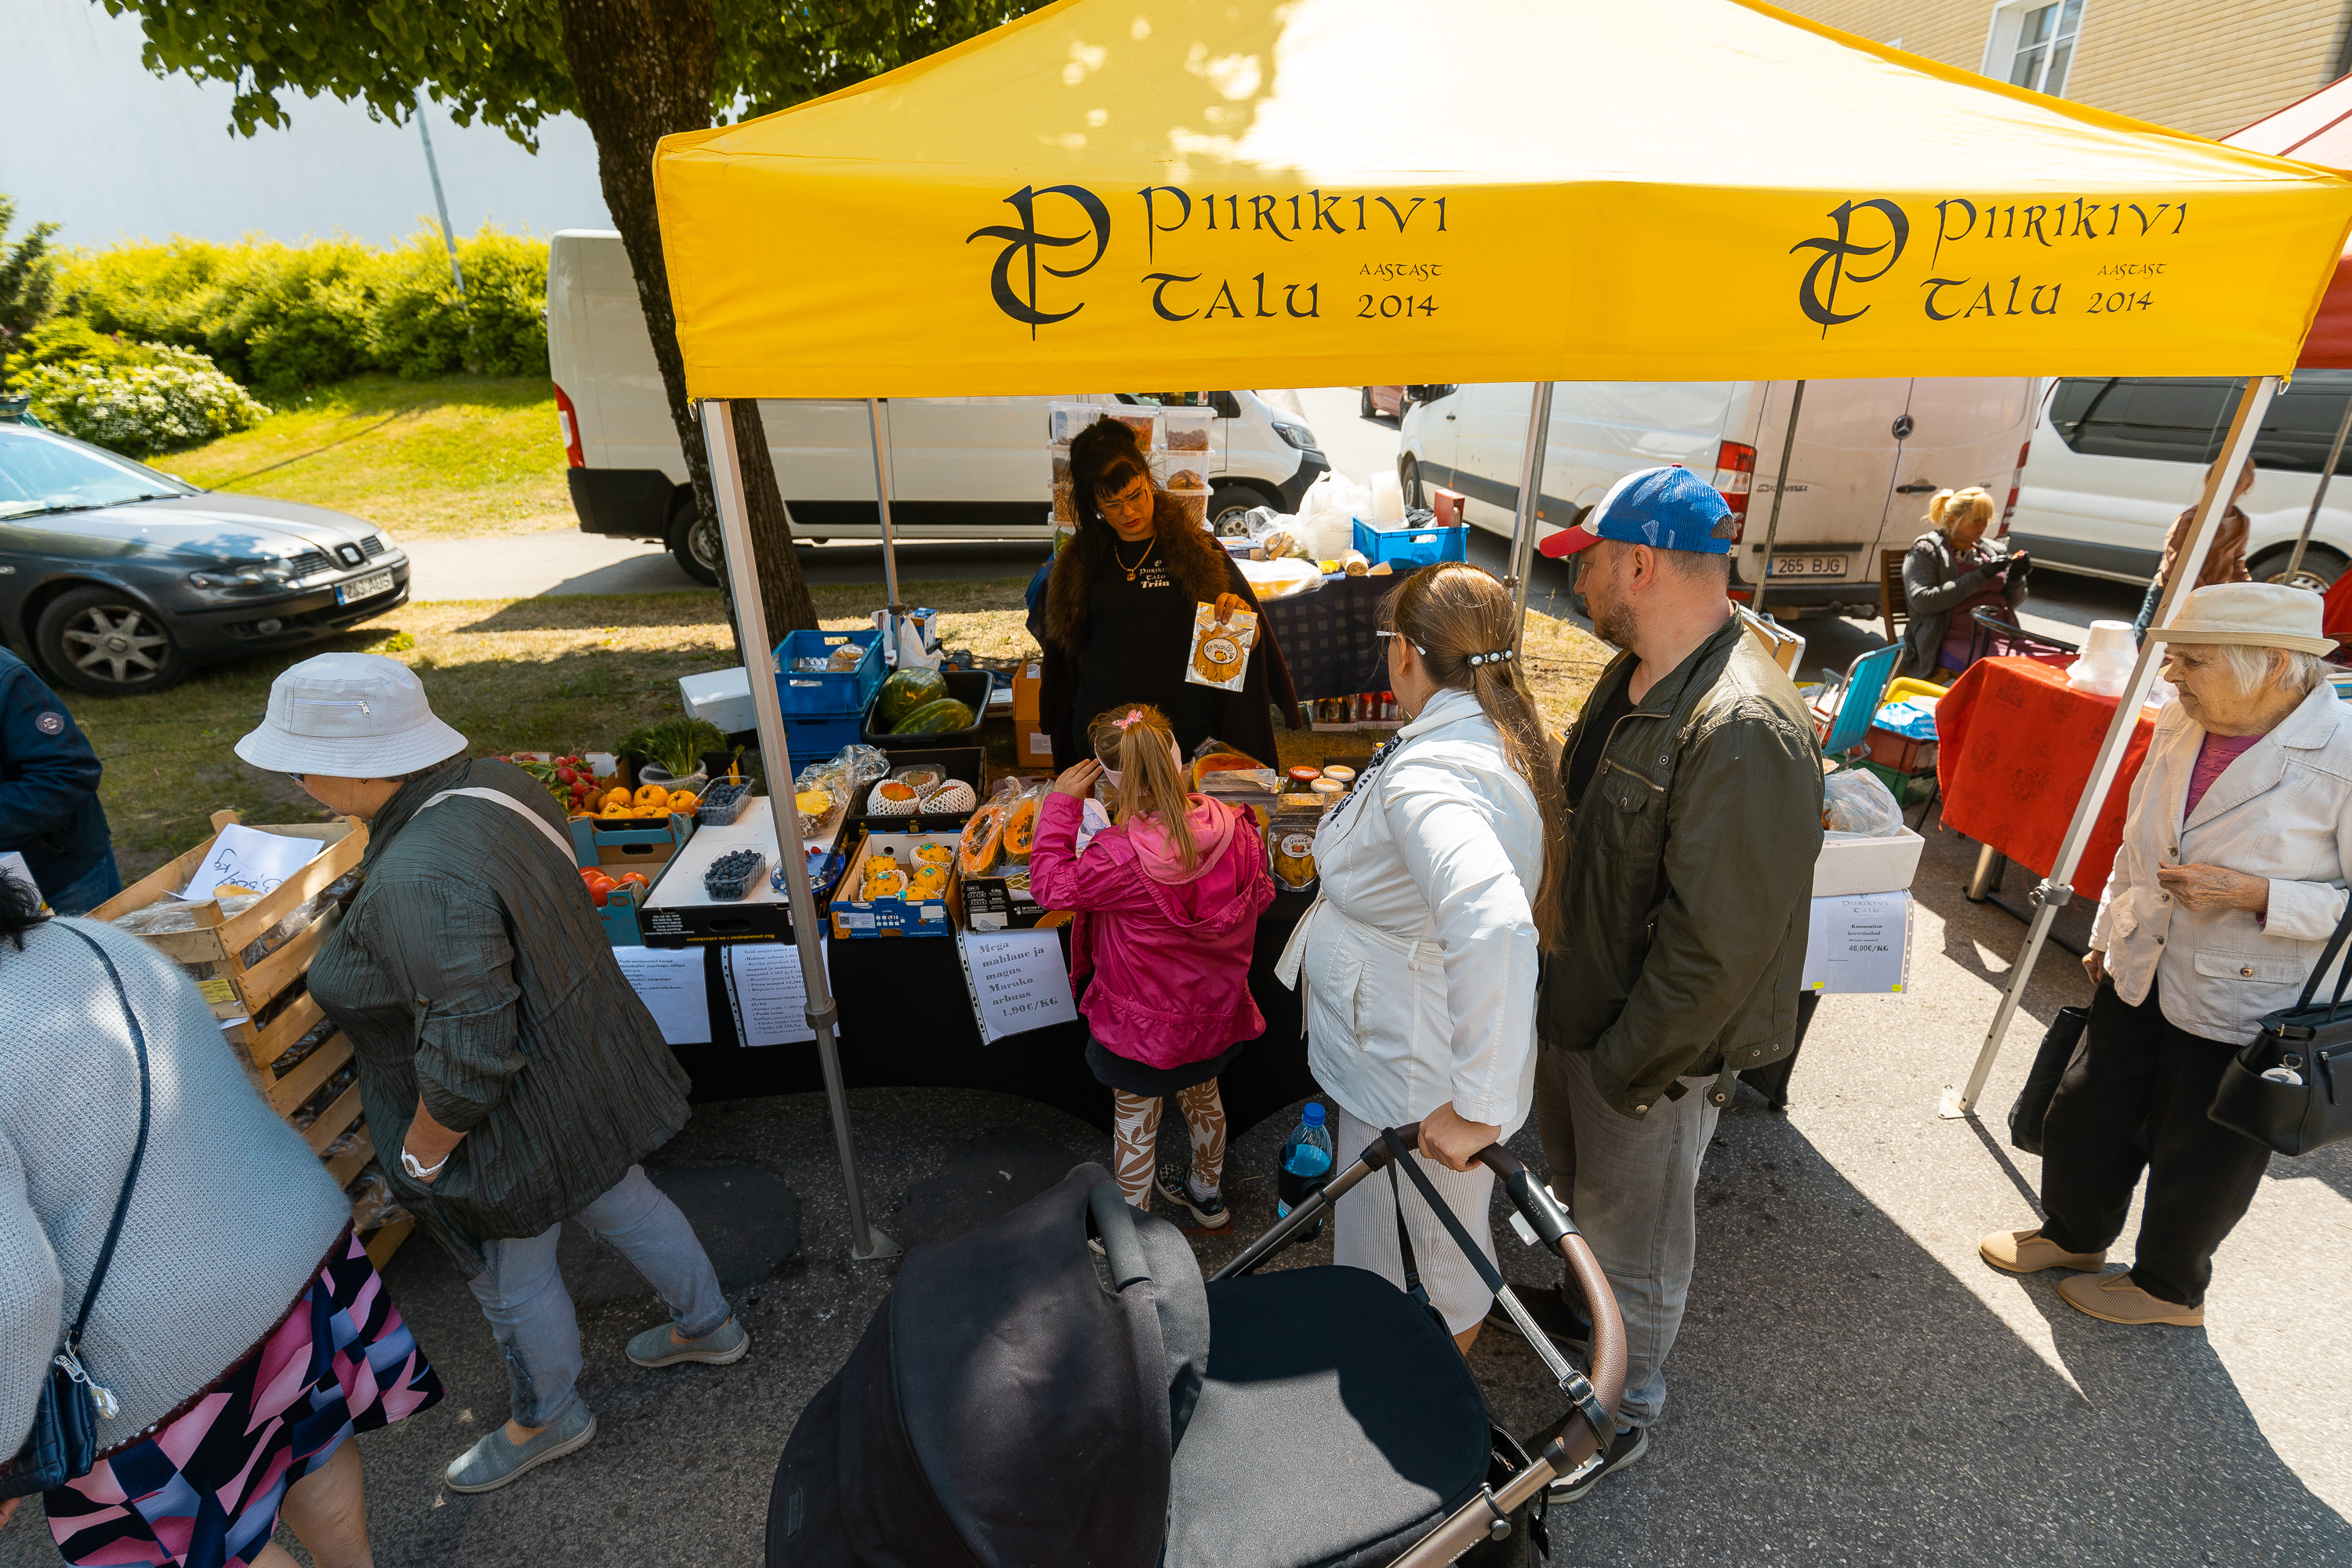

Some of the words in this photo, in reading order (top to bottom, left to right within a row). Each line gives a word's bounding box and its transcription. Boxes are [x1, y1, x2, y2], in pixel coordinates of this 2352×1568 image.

[1137, 186, 1447, 265] PIIRIKIVI
[1931, 197, 2187, 271] PIIRIKIVI
[1359, 262, 1443, 282] AASTAST
[2096, 263, 2169, 280] AASTAST
[1356, 294, 1439, 319] 2014
[2085, 289, 2154, 314] 2014
[1778, 558, 1804, 573] 265
[1812, 558, 1840, 572] BJG
[1141, 579, 1170, 589] Triin
[978, 941, 1010, 955] Mega
[982, 952, 1030, 967] mahlane
[1033, 946, 1045, 957] ja
[985, 967, 1022, 981] magus
[989, 978, 1033, 993] Maroko
[993, 991, 1032, 1006] arbuus
